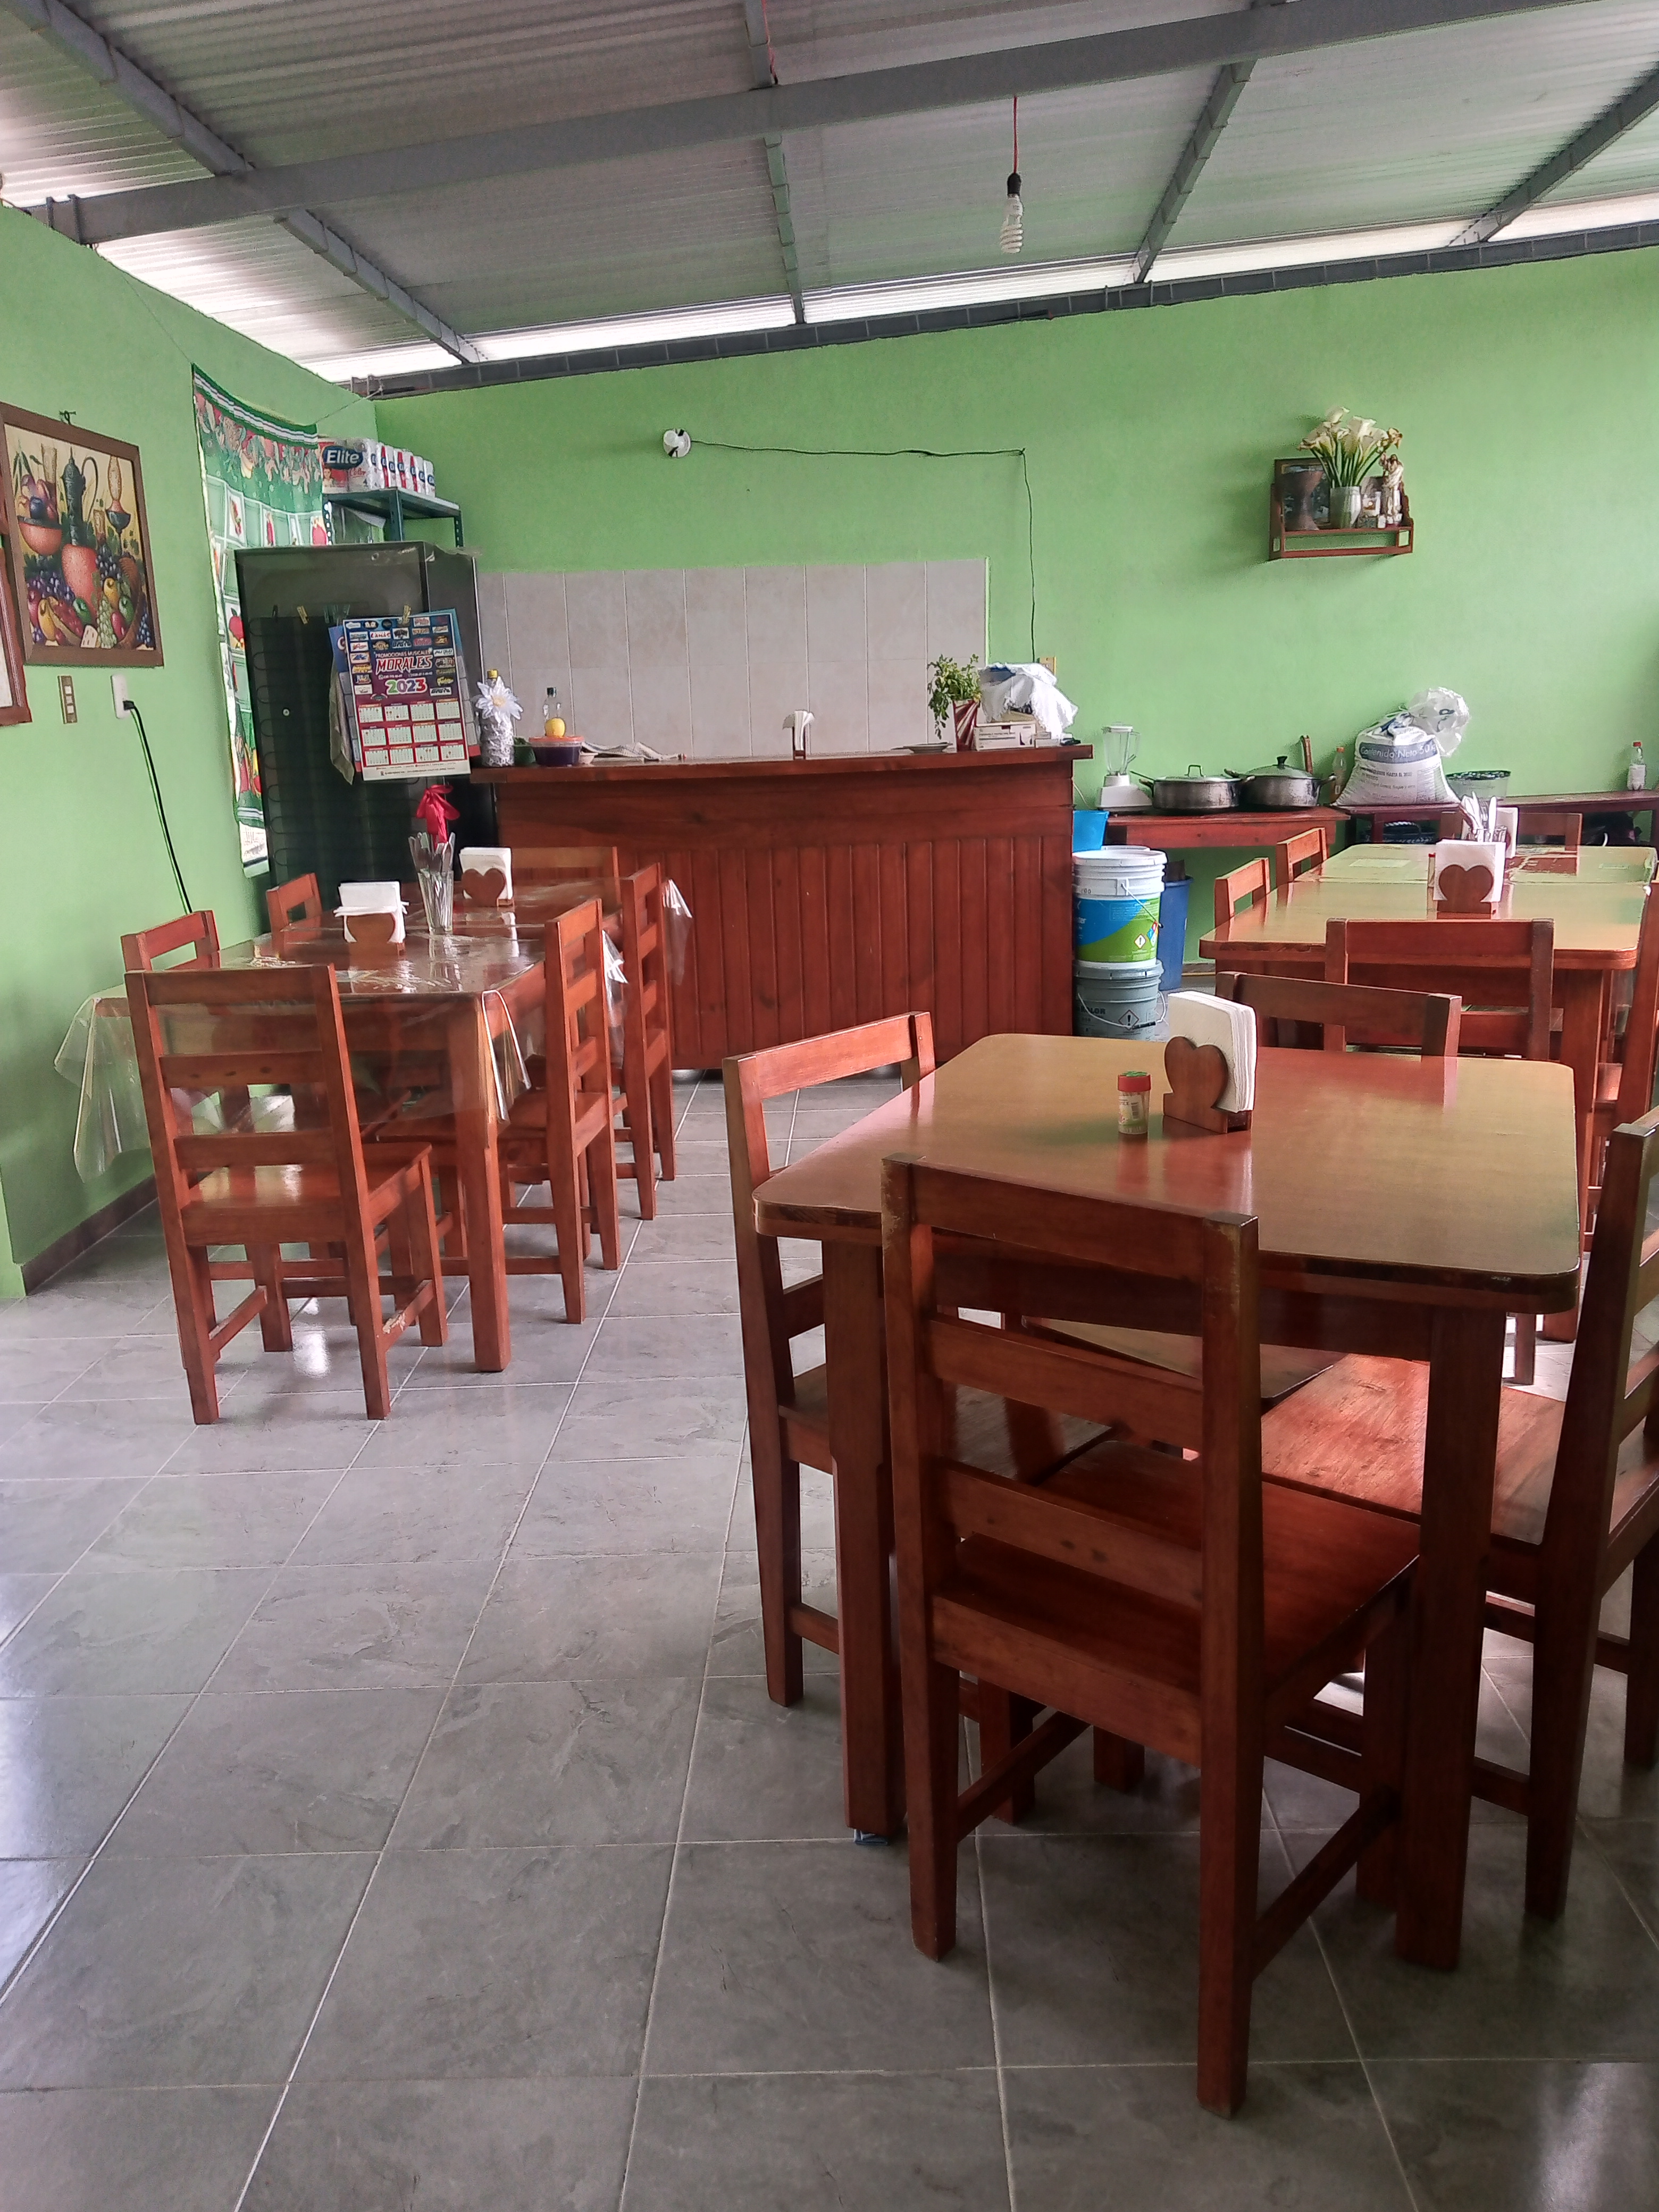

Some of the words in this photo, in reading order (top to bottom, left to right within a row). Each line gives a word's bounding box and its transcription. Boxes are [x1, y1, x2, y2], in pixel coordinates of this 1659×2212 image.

[326, 449, 359, 464] Elite
[375, 655, 433, 675] MORALES
[384, 677, 428, 694] 2023
[1360, 746, 1395, 758] Contenido
[1397, 749, 1417, 758] Neto
